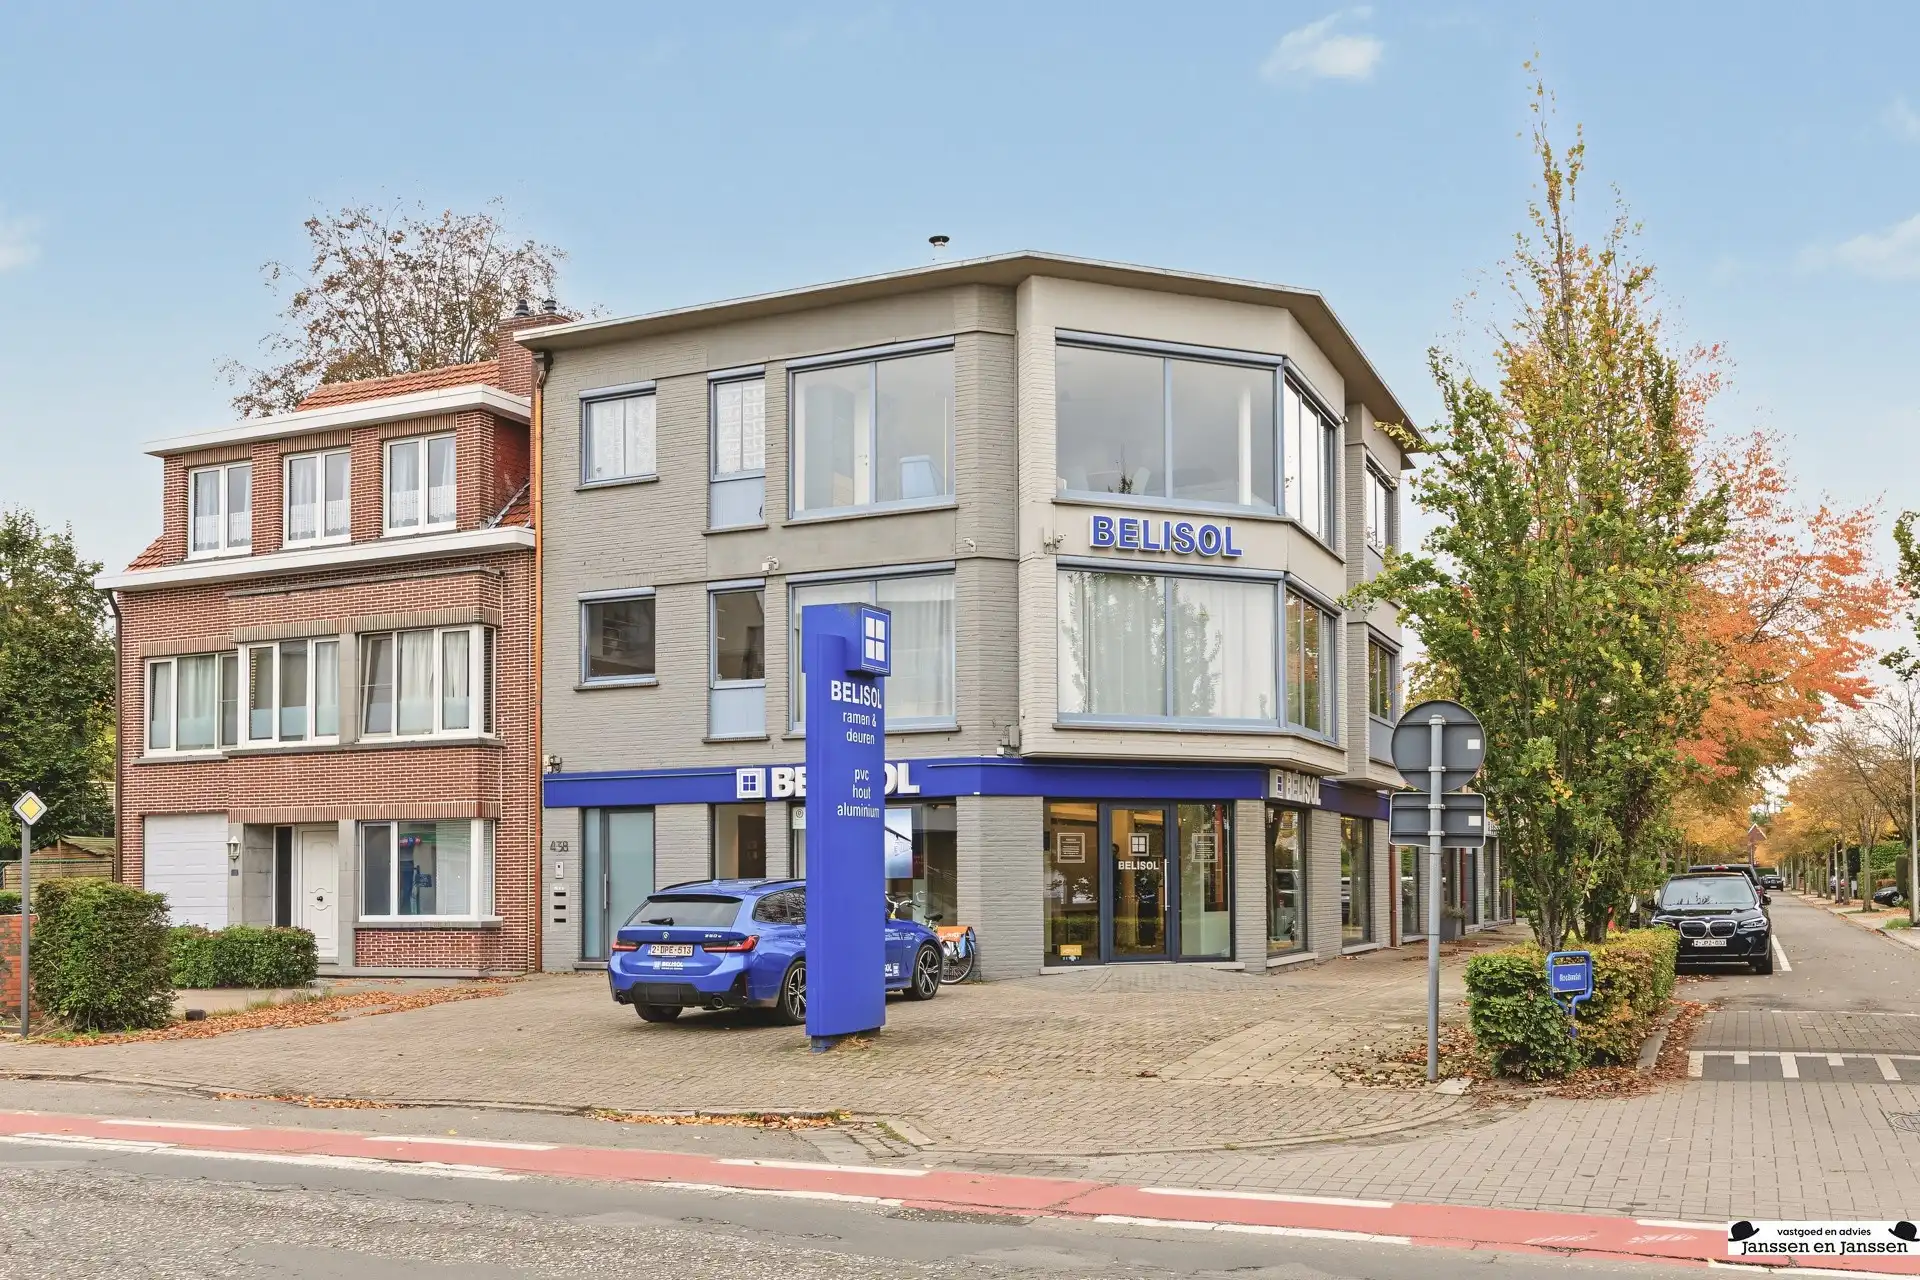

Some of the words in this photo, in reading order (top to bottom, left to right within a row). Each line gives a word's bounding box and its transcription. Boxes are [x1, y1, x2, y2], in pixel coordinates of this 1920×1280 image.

[1090, 515, 1243, 557] BELISOL
[830, 680, 882, 709] BELISOL
[843, 711, 870, 726] ramen
[871, 713, 877, 727] &
[846, 730, 875, 745] deuren
[854, 767, 870, 782] pvc
[852, 785, 871, 800] hout
[1284, 771, 1321, 805] BELISOL
[837, 803, 880, 819] aluminium
[550, 840, 569, 852] 438
[1118, 861, 1159, 871] BELISOL
